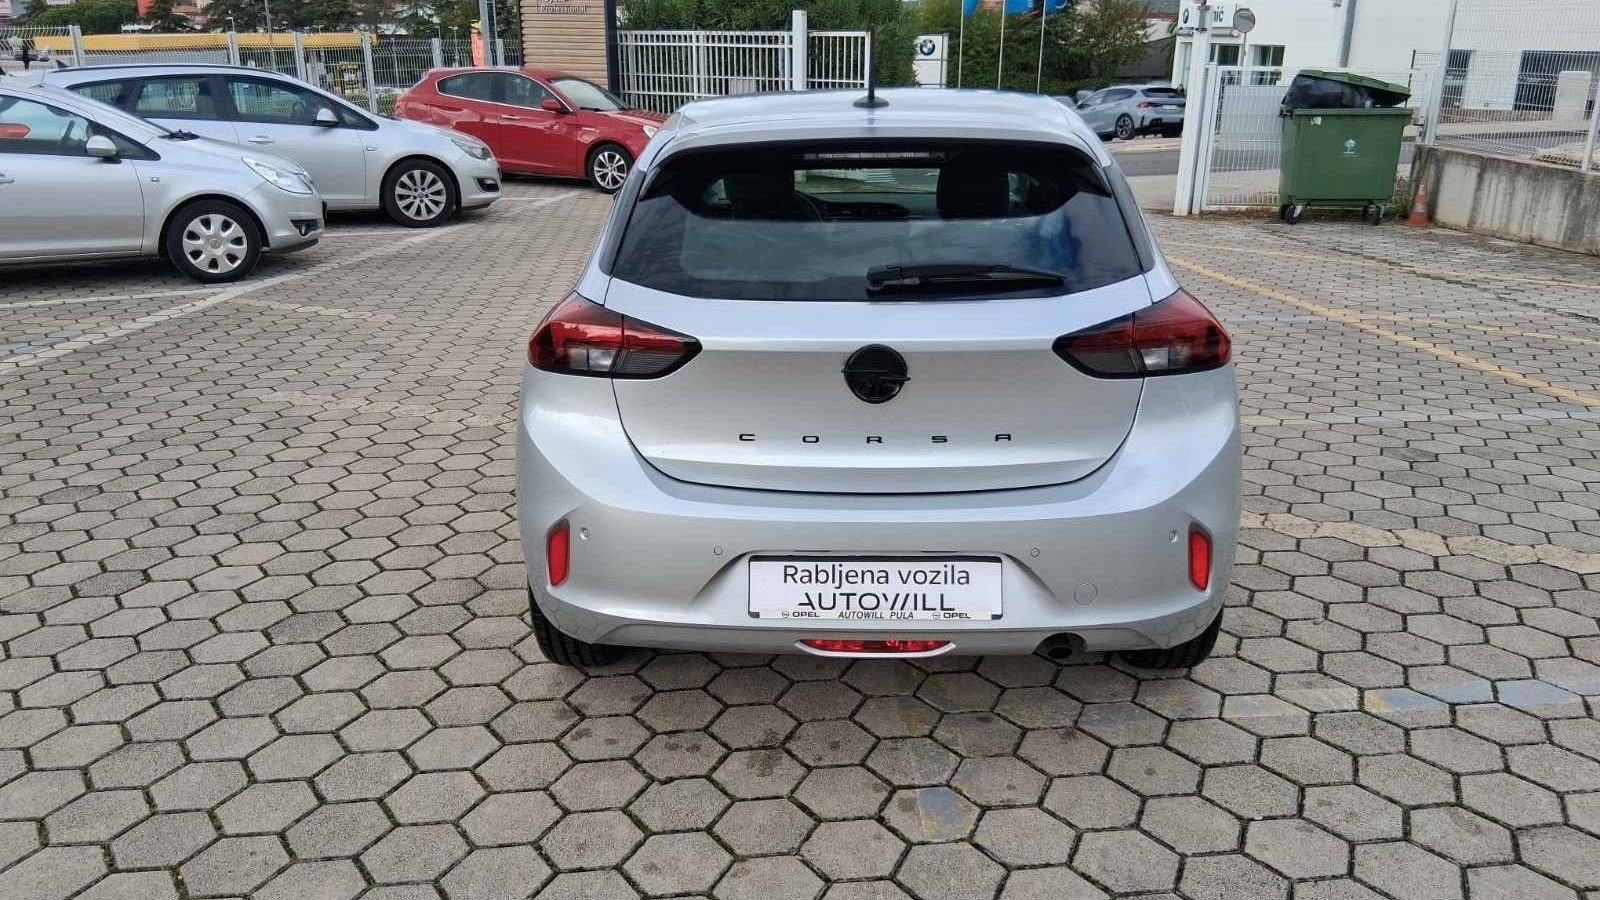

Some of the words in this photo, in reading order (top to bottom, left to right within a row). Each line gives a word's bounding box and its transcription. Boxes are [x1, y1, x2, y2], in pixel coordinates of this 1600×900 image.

[739, 433, 1012, 444] CORSA
[783, 564, 889, 589] Rabljena
[898, 564, 970, 585] vozila
[798, 592, 955, 611] AUTOWILL
